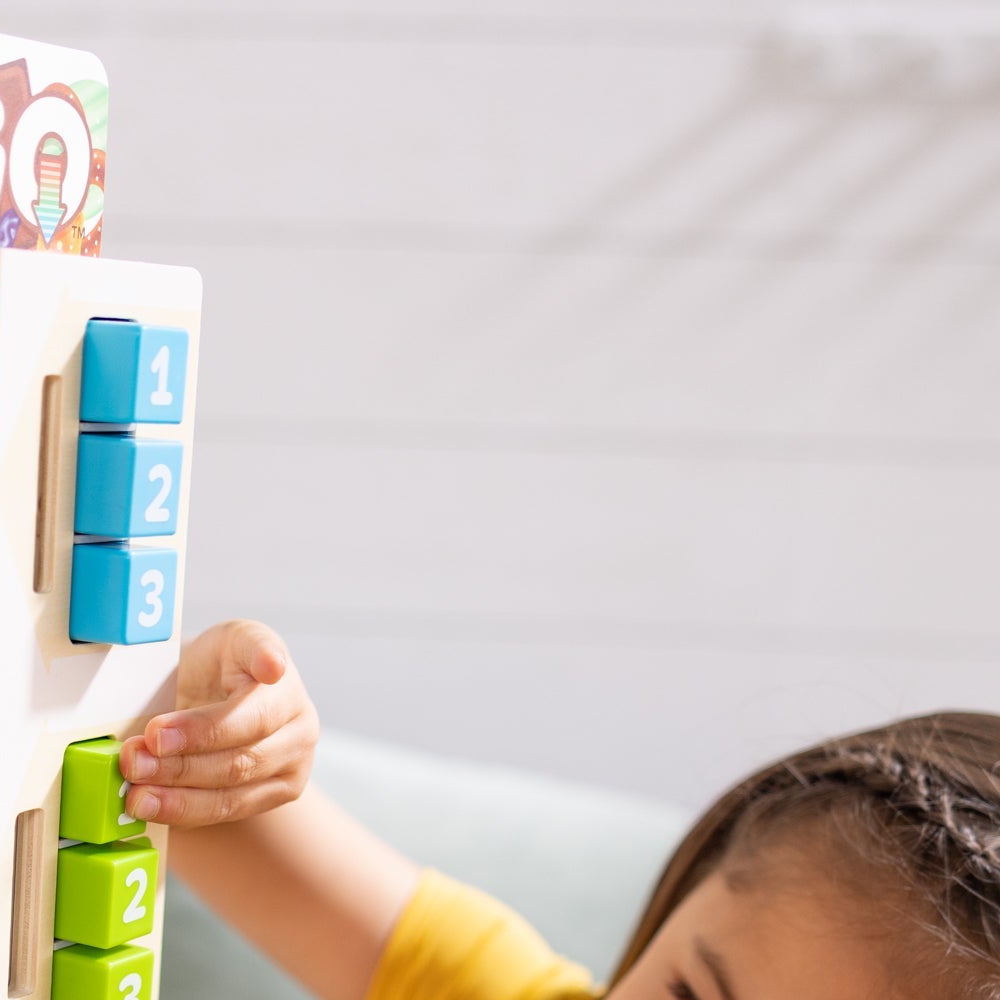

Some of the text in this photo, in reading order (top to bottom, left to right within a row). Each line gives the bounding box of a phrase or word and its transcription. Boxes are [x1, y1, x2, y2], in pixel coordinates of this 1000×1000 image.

[150, 346, 173, 406] 1
[144, 463, 173, 523] 2
[137, 568, 165, 627] 3
[122, 867, 149, 924] 2
